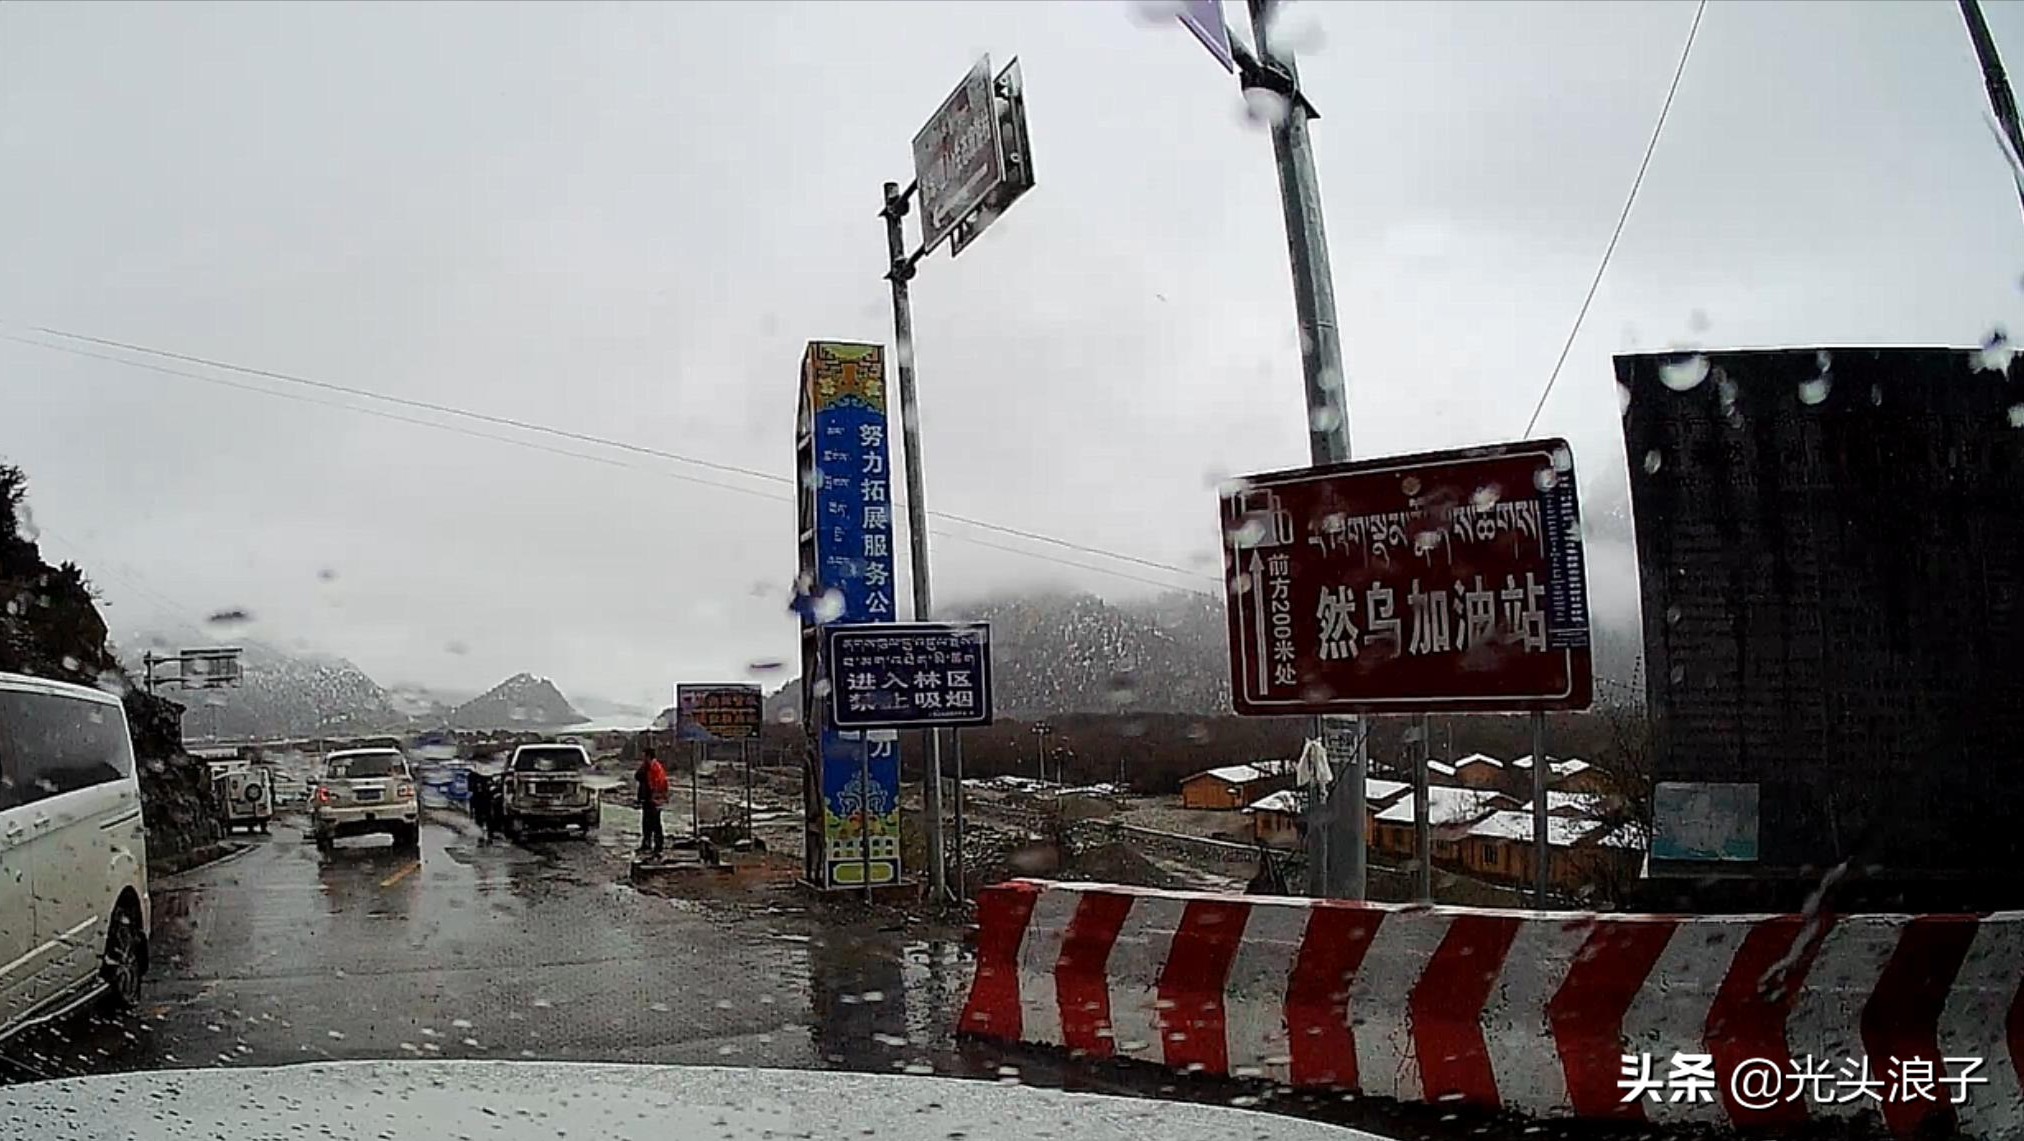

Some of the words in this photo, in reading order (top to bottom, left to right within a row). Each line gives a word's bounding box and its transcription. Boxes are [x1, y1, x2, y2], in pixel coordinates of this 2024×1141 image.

[859, 423, 889, 614] 努力拓展服务公
[1267, 553, 1298, 686] 前方200米处
[1315, 572, 1547, 660] 然乌加油站
[847, 671, 973, 690] 进入林区
[849, 690, 974, 712] 禁止吸烟
